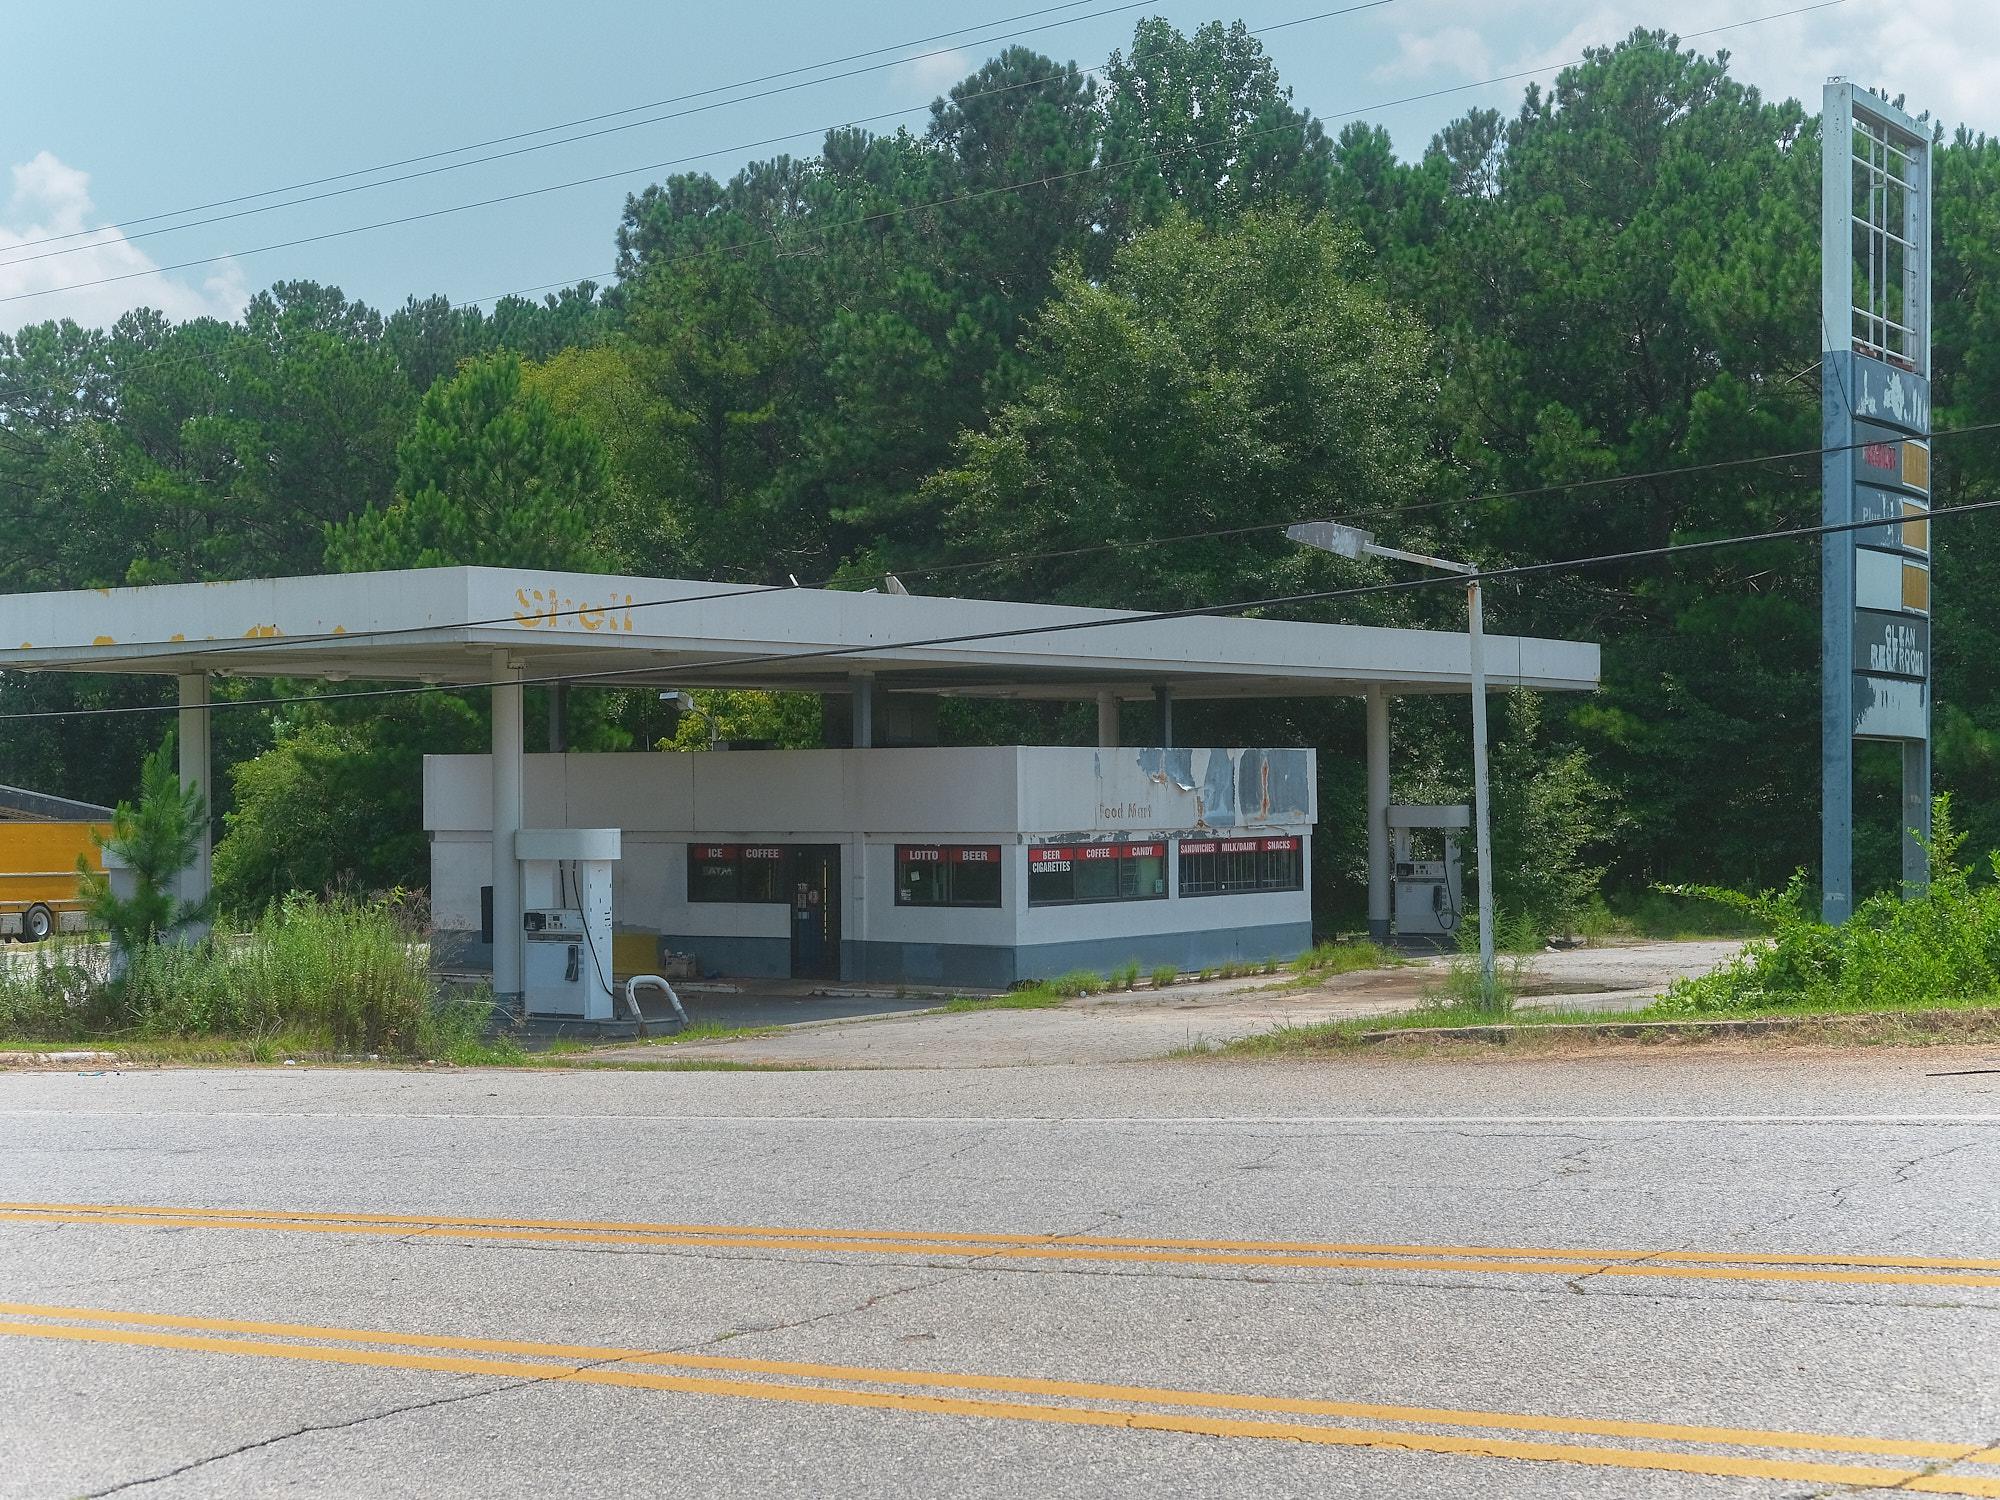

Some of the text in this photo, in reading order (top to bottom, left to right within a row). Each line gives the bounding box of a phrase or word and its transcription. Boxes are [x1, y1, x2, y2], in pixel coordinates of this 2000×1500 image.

[1885, 624, 1916, 650] CLEAN
[1180, 843, 1215, 854] SANDWICHES
[1221, 842, 1257, 852] MILK/DAIRY
[1267, 840, 1291, 850] SNACKS
[708, 848, 723, 858] ICE
[745, 848, 779, 858] COFFEE
[909, 850, 939, 860] LOTTO
[962, 850, 988, 861] BEER
[1042, 850, 1060, 860] BEER
[1086, 847, 1110, 858] COFFEE
[1131, 846, 1153, 856] CANDY
[1032, 861, 1071, 873] CIGARETTES
